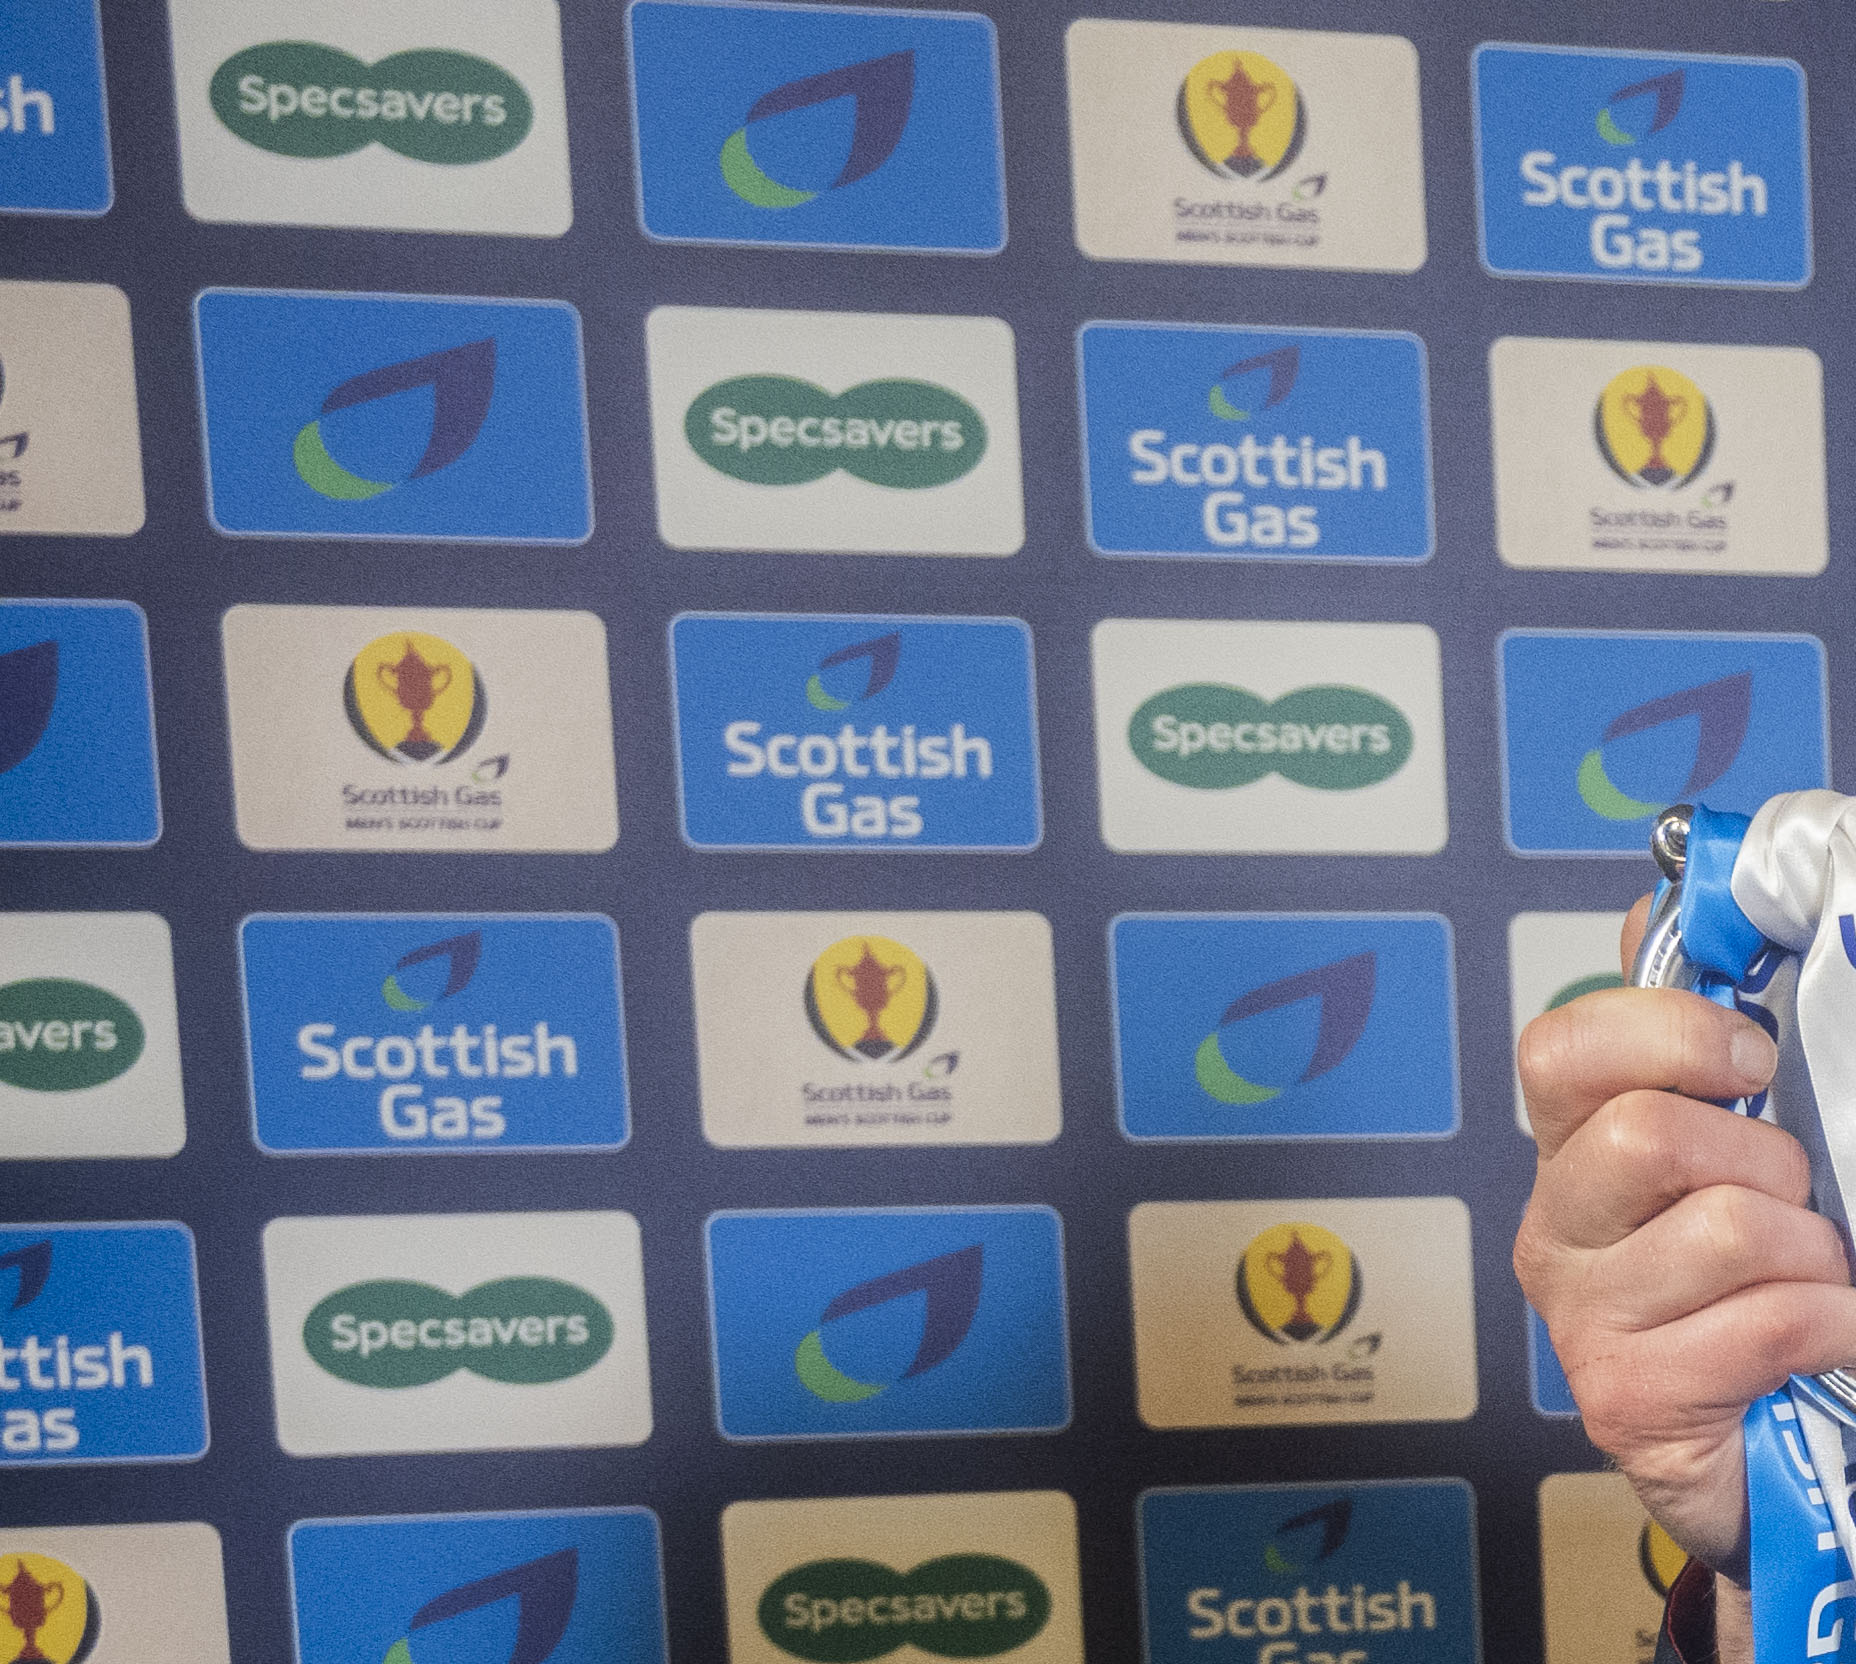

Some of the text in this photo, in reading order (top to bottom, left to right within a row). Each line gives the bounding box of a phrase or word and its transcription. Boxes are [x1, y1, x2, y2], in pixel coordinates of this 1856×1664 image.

[239, 75, 506, 126] Specsavers
[1174, 197, 1271, 220] Scottish
[1519, 150, 1768, 216] Scottish
[1589, 212, 1704, 268] Gas
[711, 407, 963, 451] Specsavers
[1128, 428, 1388, 491] Scottish
[1202, 490, 1321, 542] Gas
[723, 720, 993, 779] Scottish
[1152, 715, 1391, 758] Specsavers
[343, 784, 449, 805] Scottish
[800, 781, 924, 831] Gas
[296, 1021, 579, 1080] Scottish
[378, 1082, 507, 1137] Gas
[803, 1082, 901, 1101] Scottish
[331, 1311, 589, 1356] Specsavers
[783, 1585, 1025, 1630] Specsavers
[1186, 1580, 1437, 1640] Scottish
